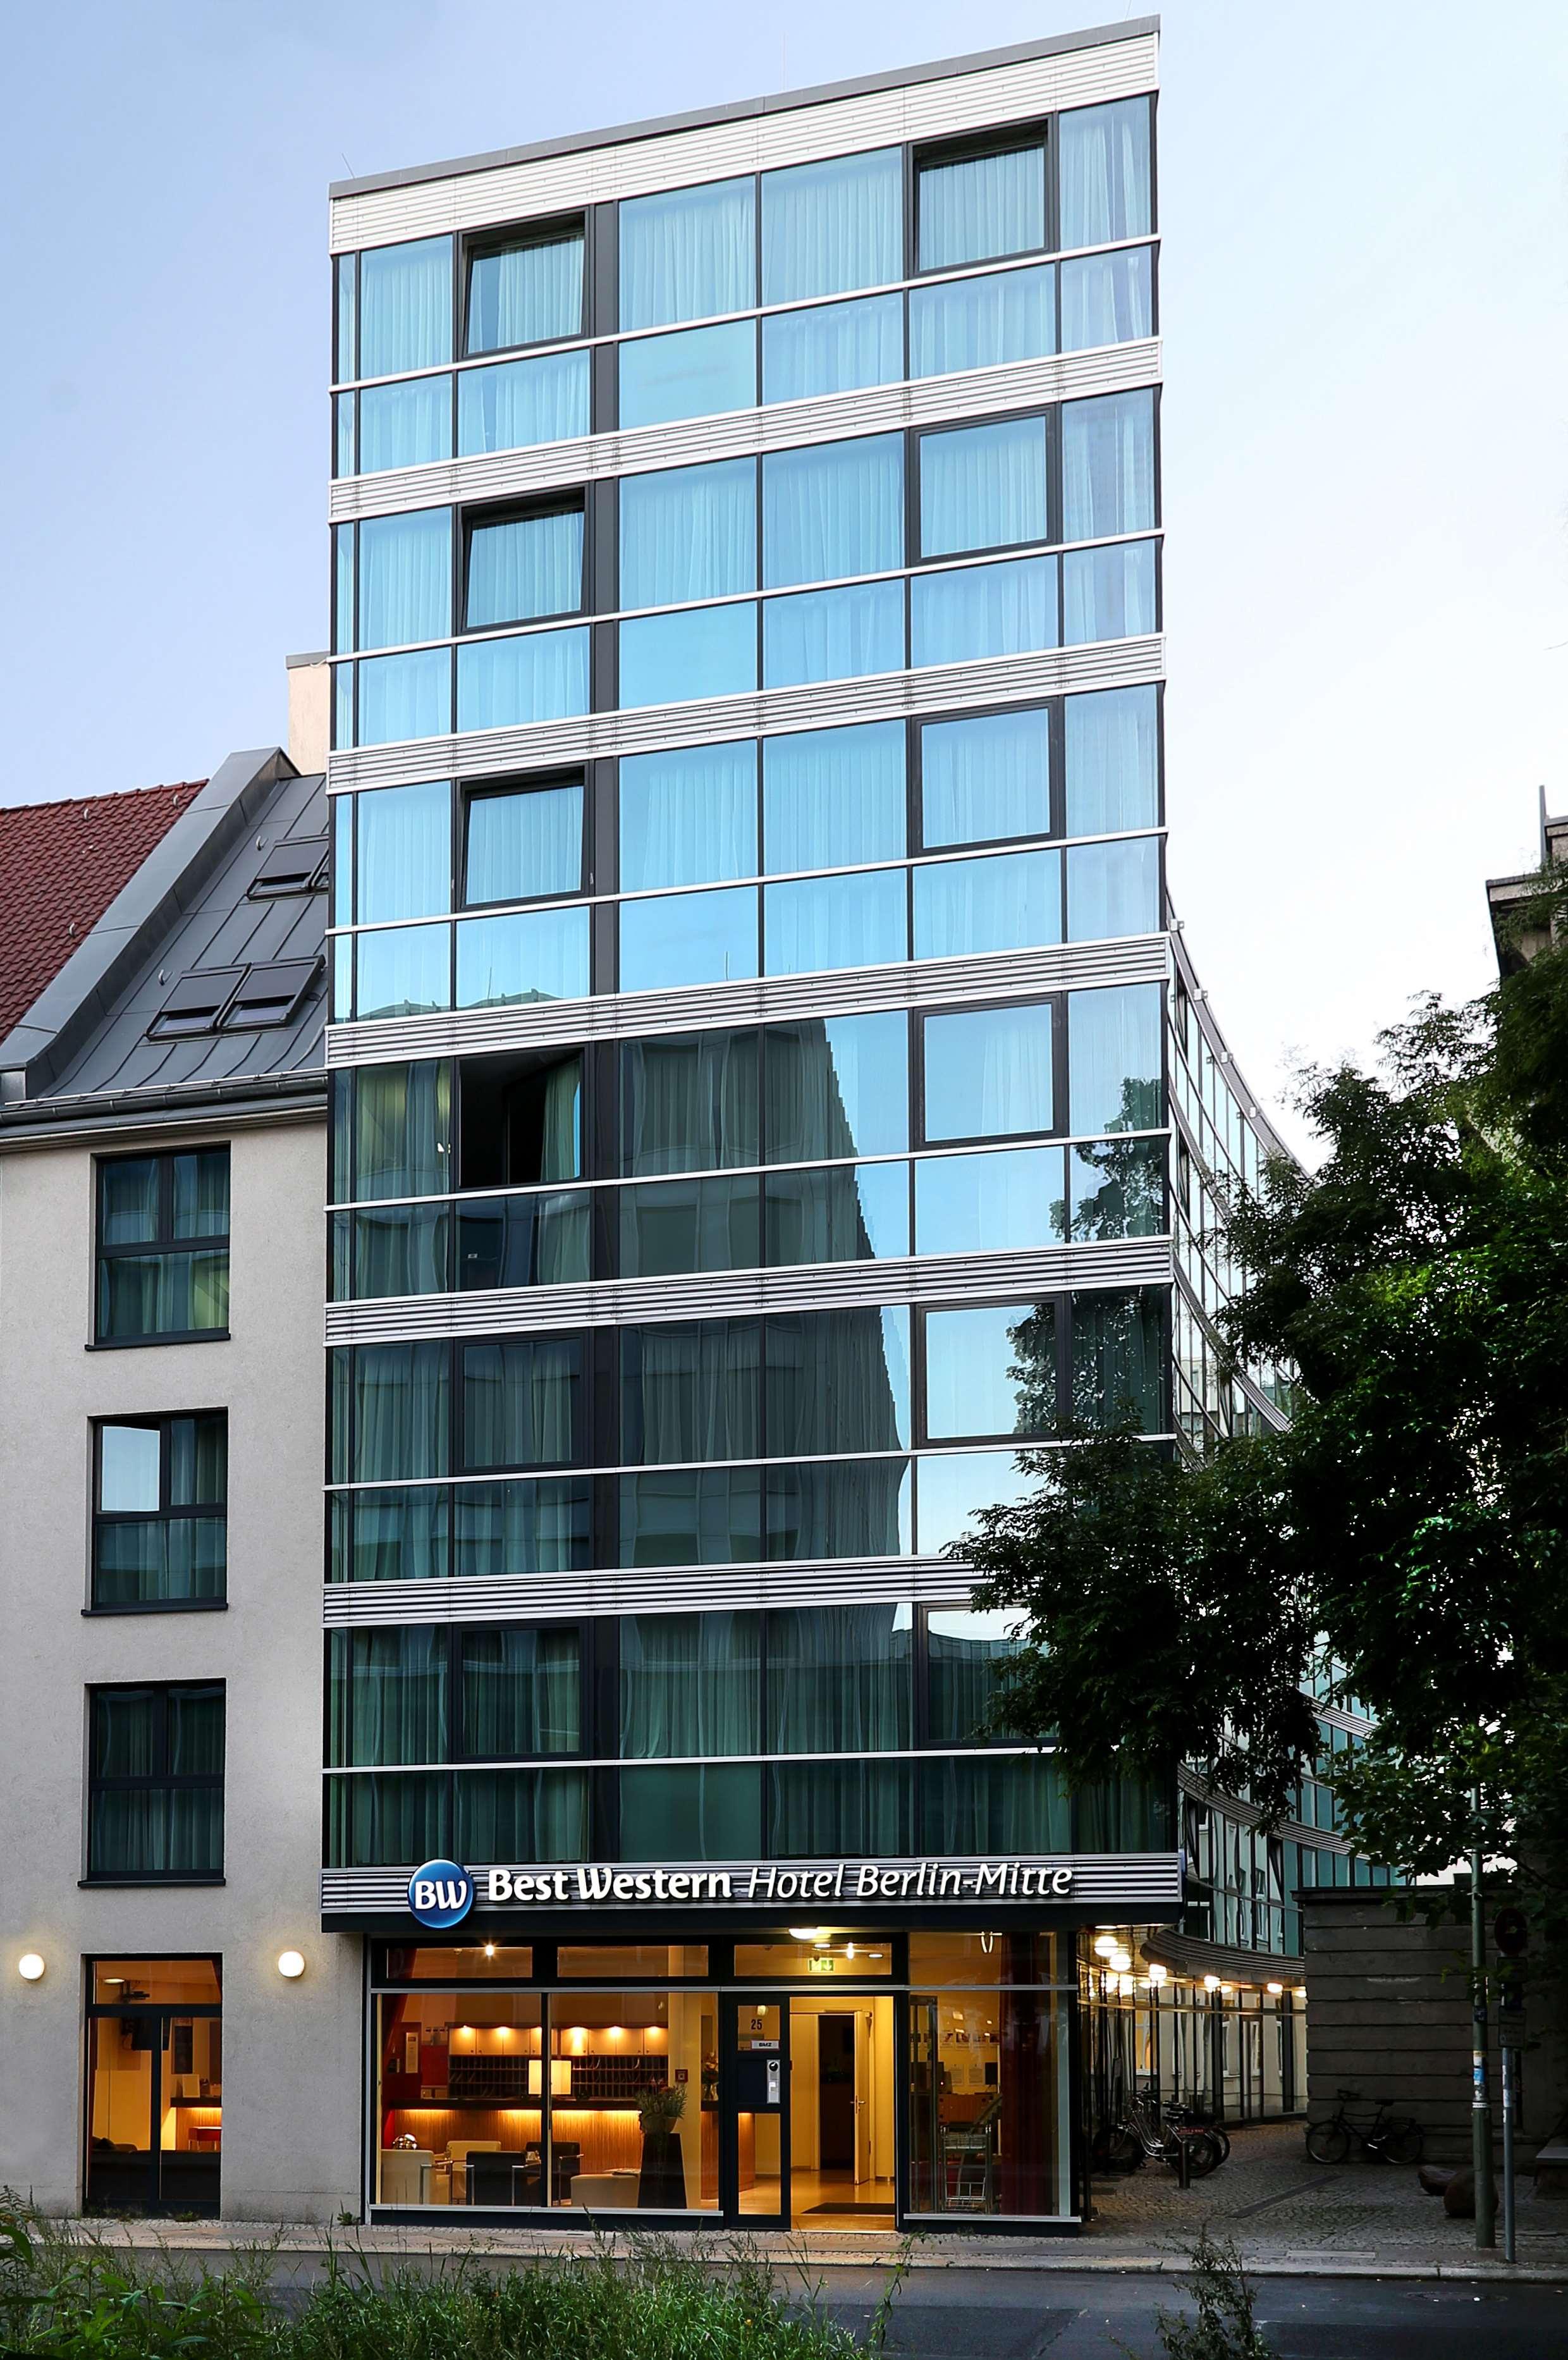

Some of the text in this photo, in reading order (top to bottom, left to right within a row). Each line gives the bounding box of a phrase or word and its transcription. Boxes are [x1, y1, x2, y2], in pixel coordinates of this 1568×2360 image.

[415, 1880, 467, 1910] BW
[487, 1862, 1072, 1900] Best Western Hotel Berlin-Mitte
[750, 2019, 763, 2030] 25
